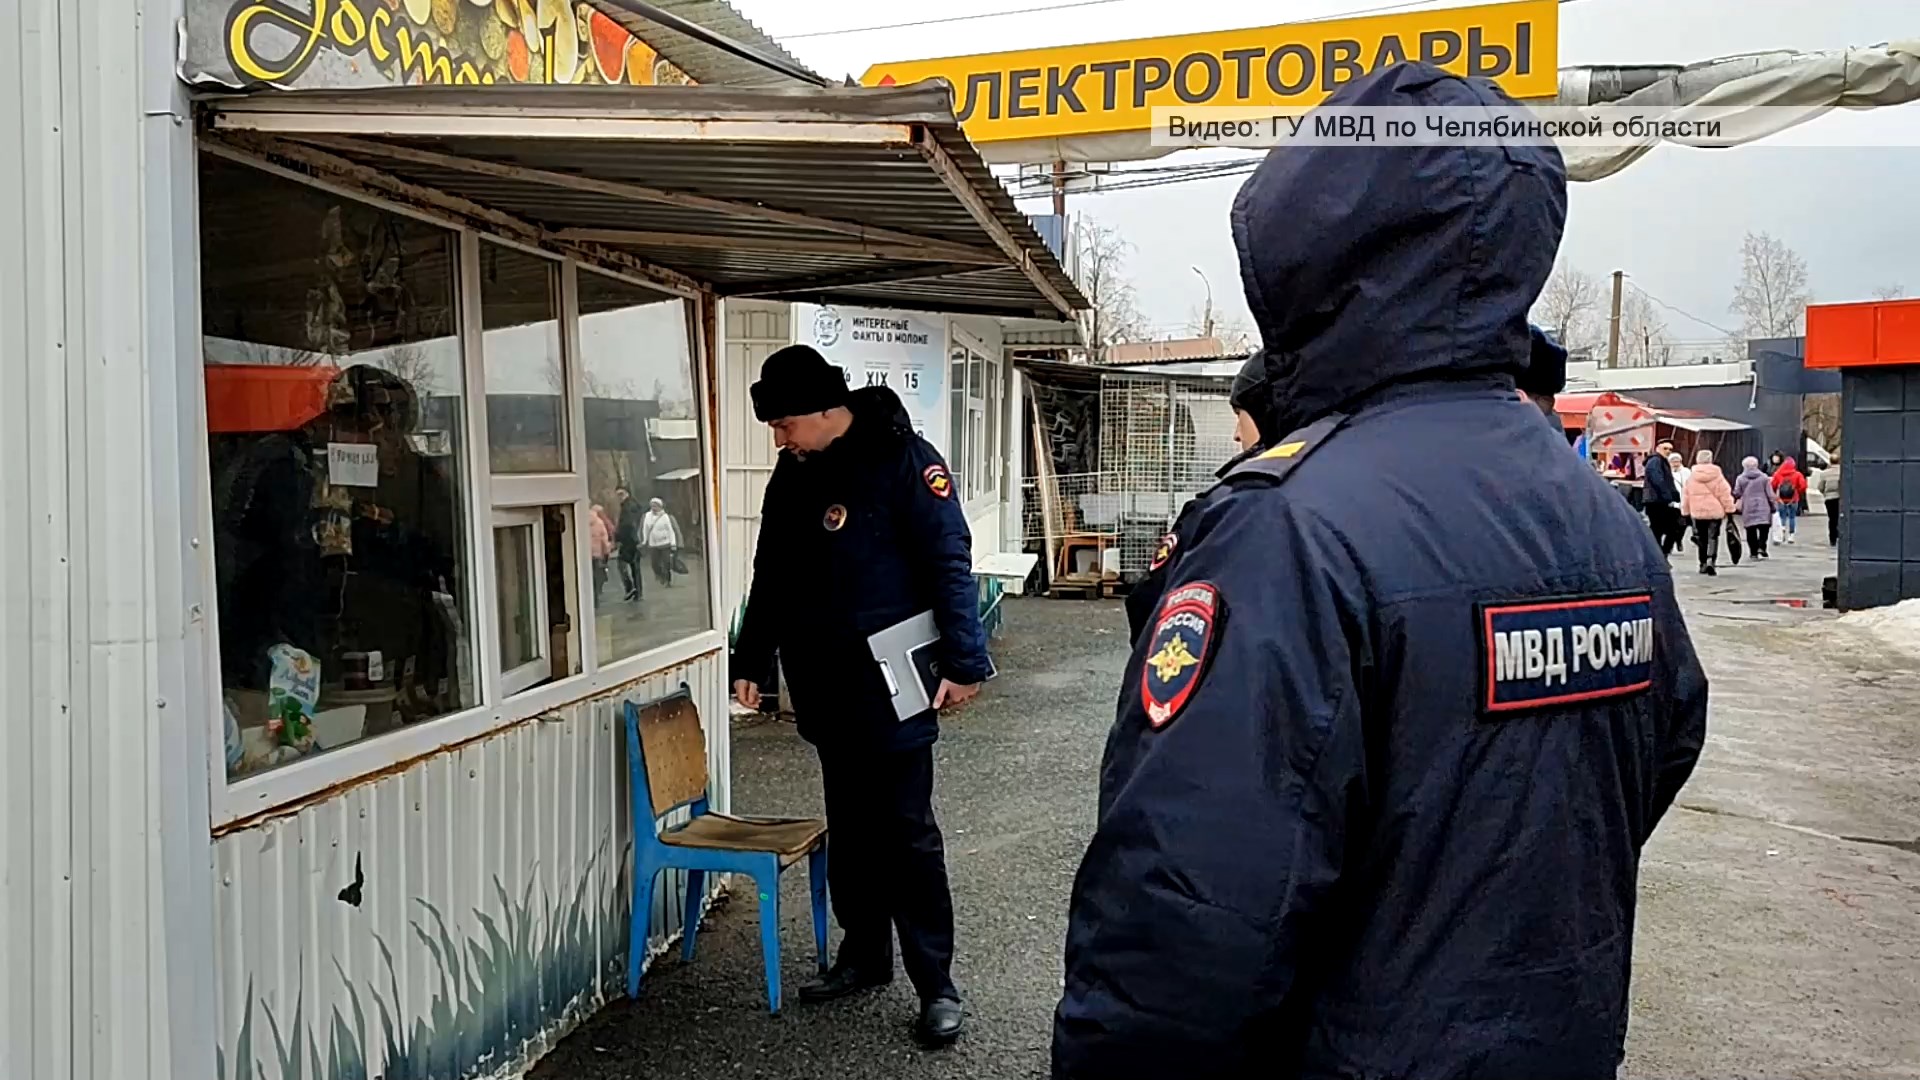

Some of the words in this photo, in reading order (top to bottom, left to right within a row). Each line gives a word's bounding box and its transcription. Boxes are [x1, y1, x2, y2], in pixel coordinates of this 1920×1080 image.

[949, 22, 1530, 122] ЛЕКТРОТОВАРЫ
[852, 317, 909, 331] ИНТЕРЕСНЫЕ
[852, 331, 885, 343] ФАКТЫ
[886, 332, 893, 342] О
[895, 333, 928, 345] МОЛОКЕ
[904, 372, 919, 389] 15
[1494, 627, 1567, 688] МВД
[1571, 617, 1653, 674] РОССИИ
